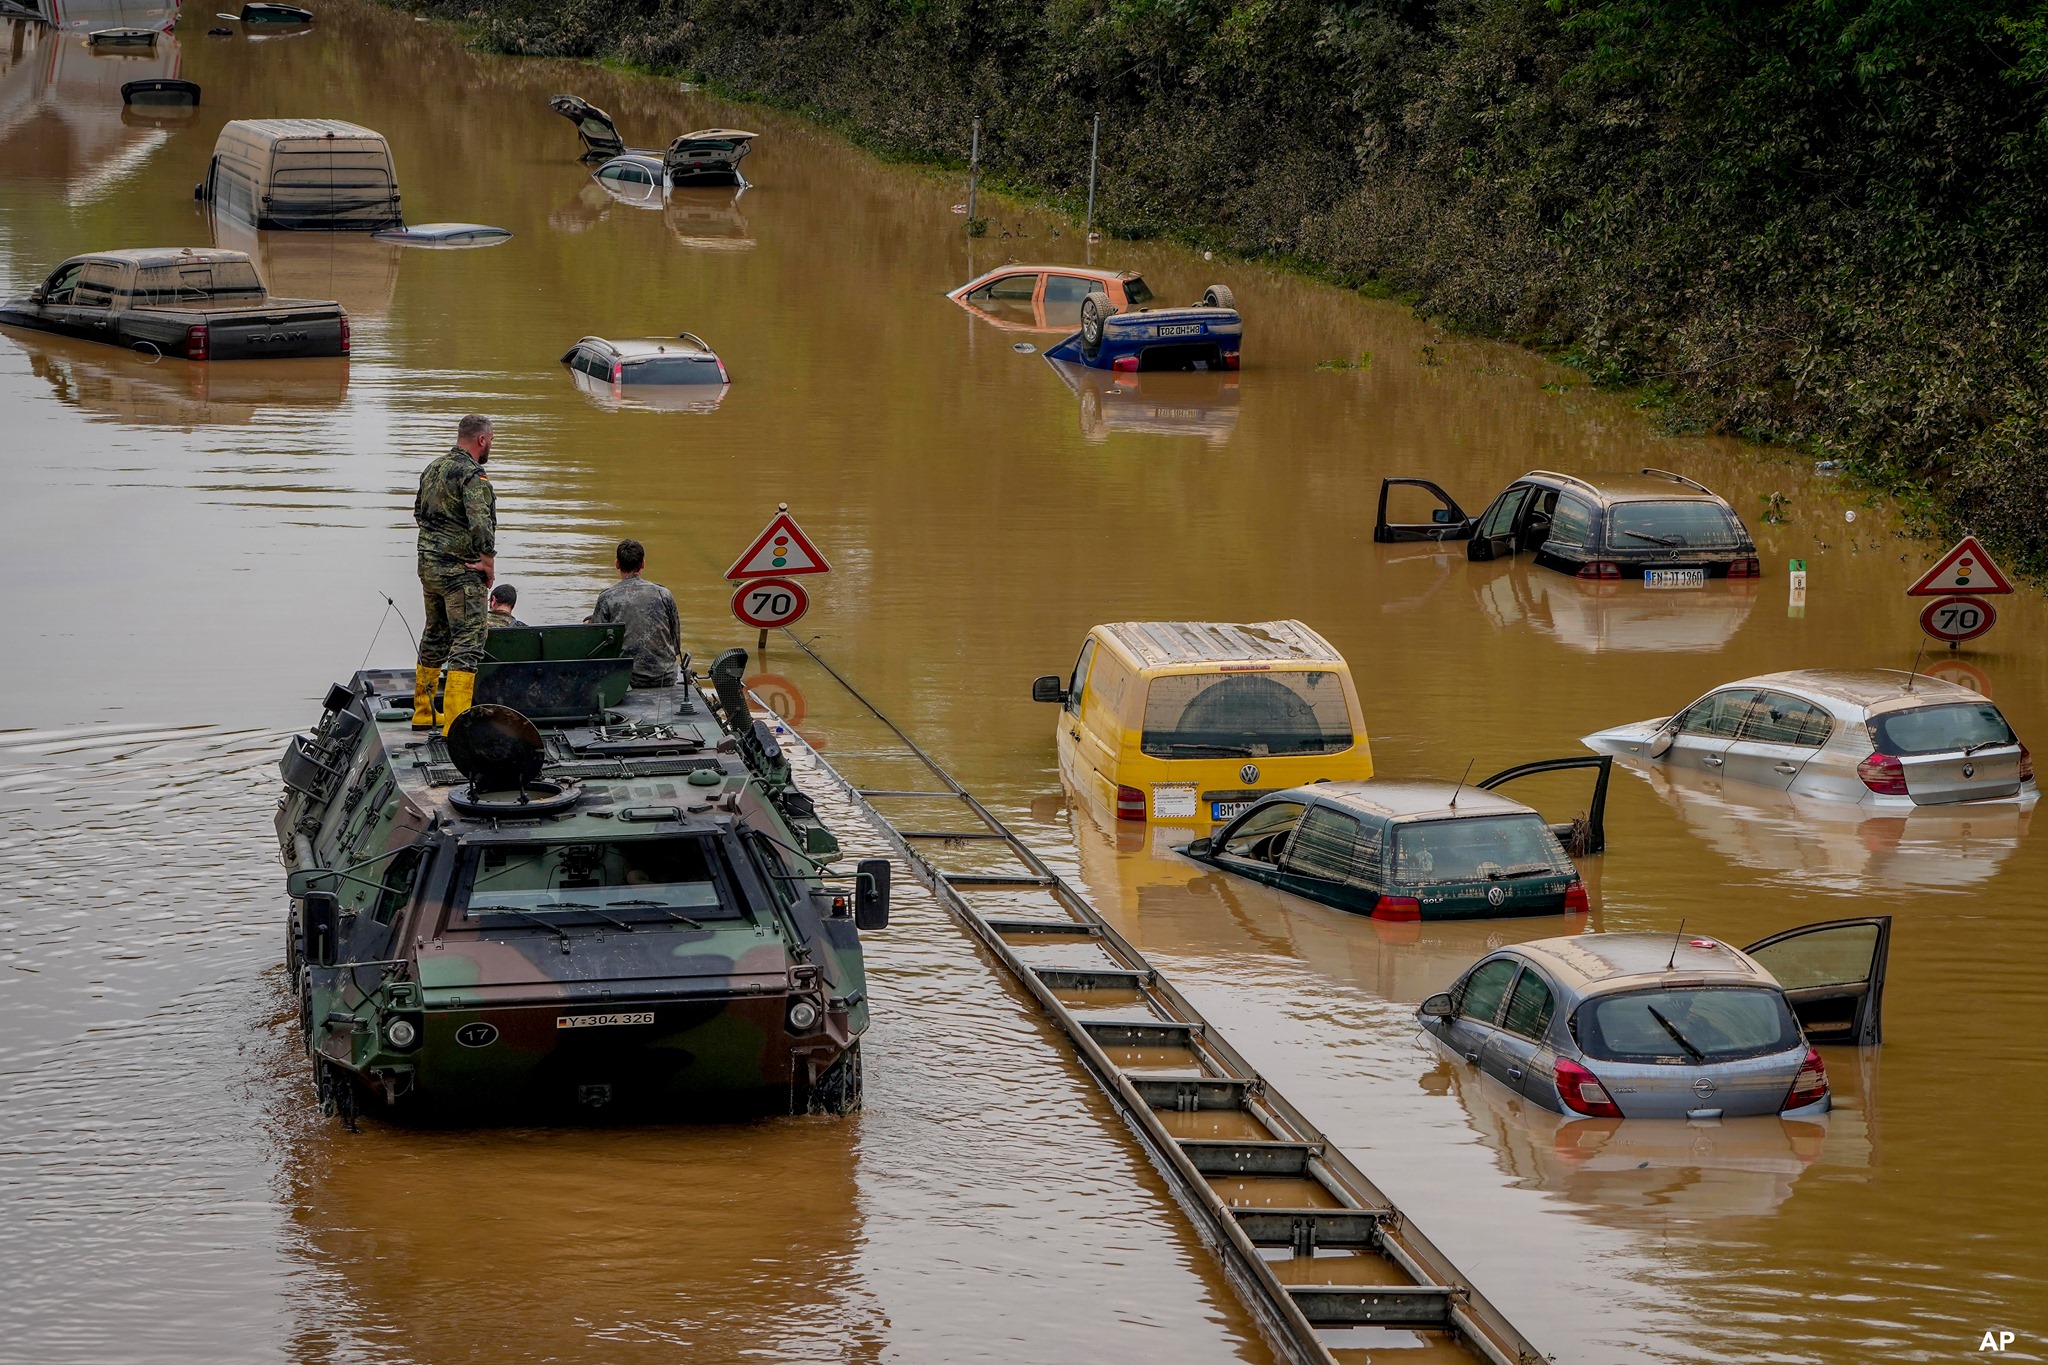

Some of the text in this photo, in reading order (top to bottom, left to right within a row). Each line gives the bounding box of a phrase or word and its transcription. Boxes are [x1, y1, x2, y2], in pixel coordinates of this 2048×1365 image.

[1160, 327, 1175, 336] 201
[1176, 326, 1186, 334] HD
[247, 331, 307, 344] RAM
[753, 593, 791, 615] 70
[1940, 609, 1979, 629] 70
[1220, 804, 1234, 816] BM
[623, 1013, 653, 1024] 326
[466, 1028, 489, 1041] 17
